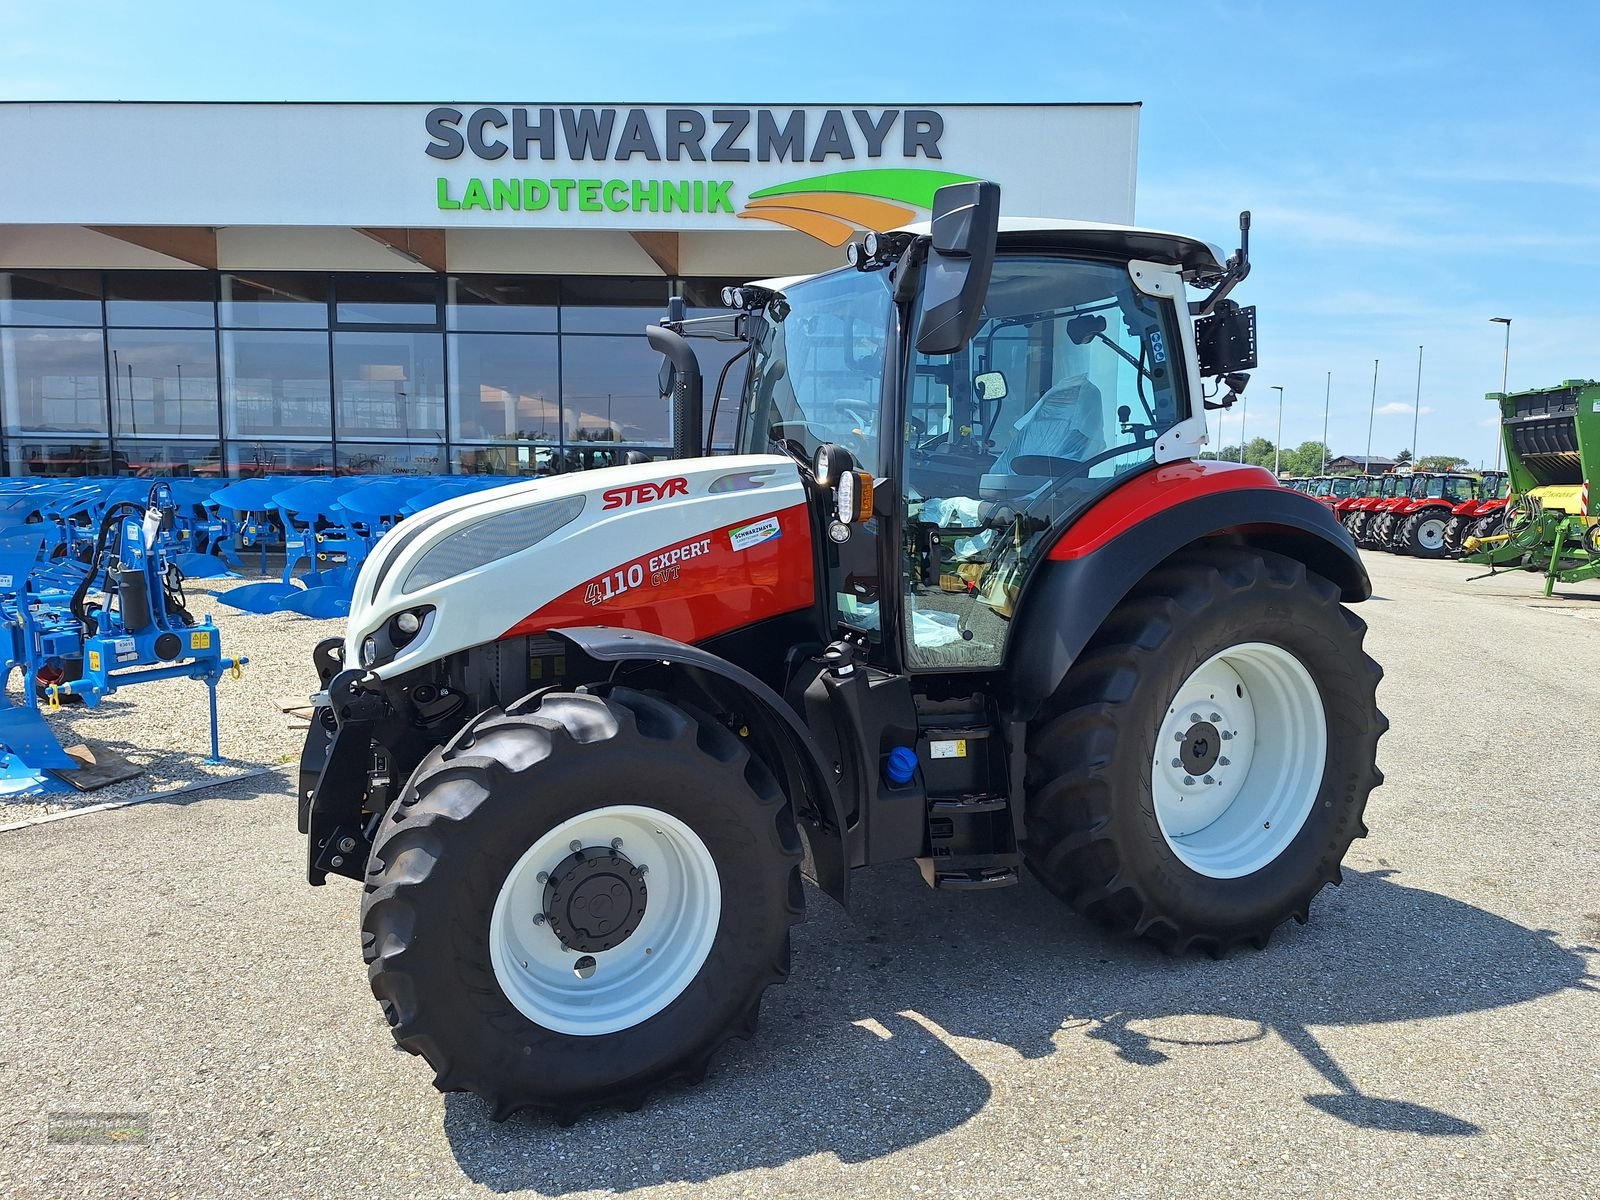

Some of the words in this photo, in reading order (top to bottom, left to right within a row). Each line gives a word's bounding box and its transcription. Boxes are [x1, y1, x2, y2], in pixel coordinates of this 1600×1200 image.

[425, 107, 944, 162] SCHWARZMAYR
[436, 177, 734, 214] LANDTECHNIK
[602, 477, 689, 510] STEYR
[735, 523, 773, 540] SCHWARZMAYR
[584, 564, 644, 606] 4110
[649, 539, 711, 572] EXPERT
[651, 565, 680, 587] CVT
